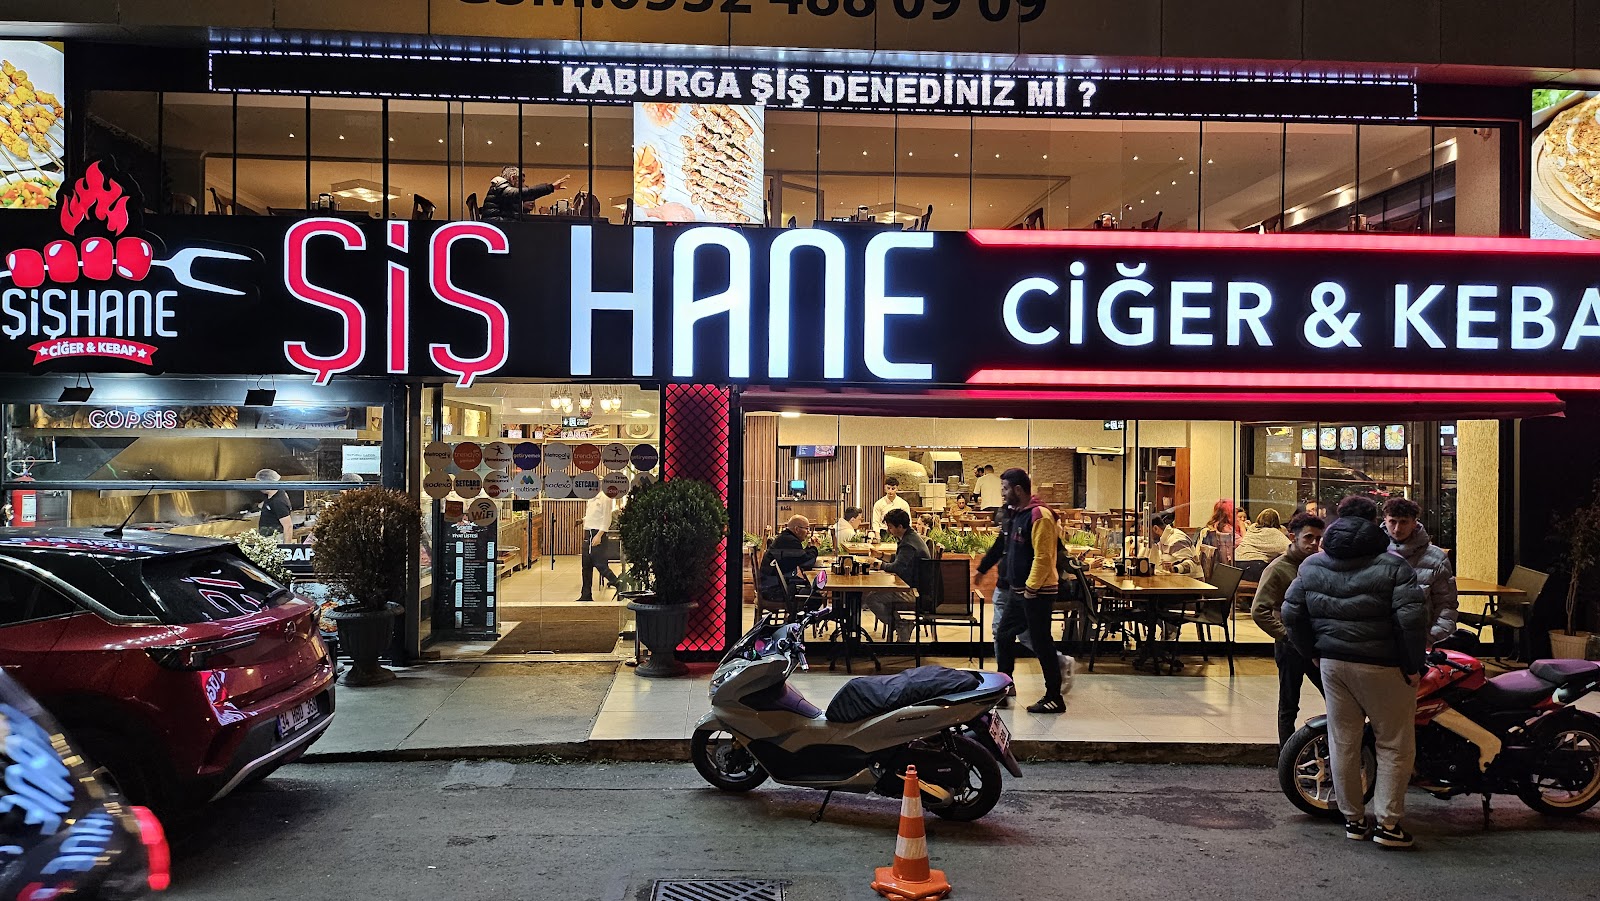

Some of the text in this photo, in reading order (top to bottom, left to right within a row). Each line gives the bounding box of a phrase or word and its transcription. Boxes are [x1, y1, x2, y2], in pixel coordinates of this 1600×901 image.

[562, 66, 1097, 108] KABURGA ŞİŞ DENEDİNİZ Mİ ?
[570, 225, 935, 380] HANE
[1002, 260, 1275, 347] CİĞER
[1303, 281, 1363, 348] &
[86, 341, 97, 353] &
[97, 342, 137, 357] KEBAP
[455, 479, 481, 487] SETCARD
[574, 480, 599, 488] SETCARD
